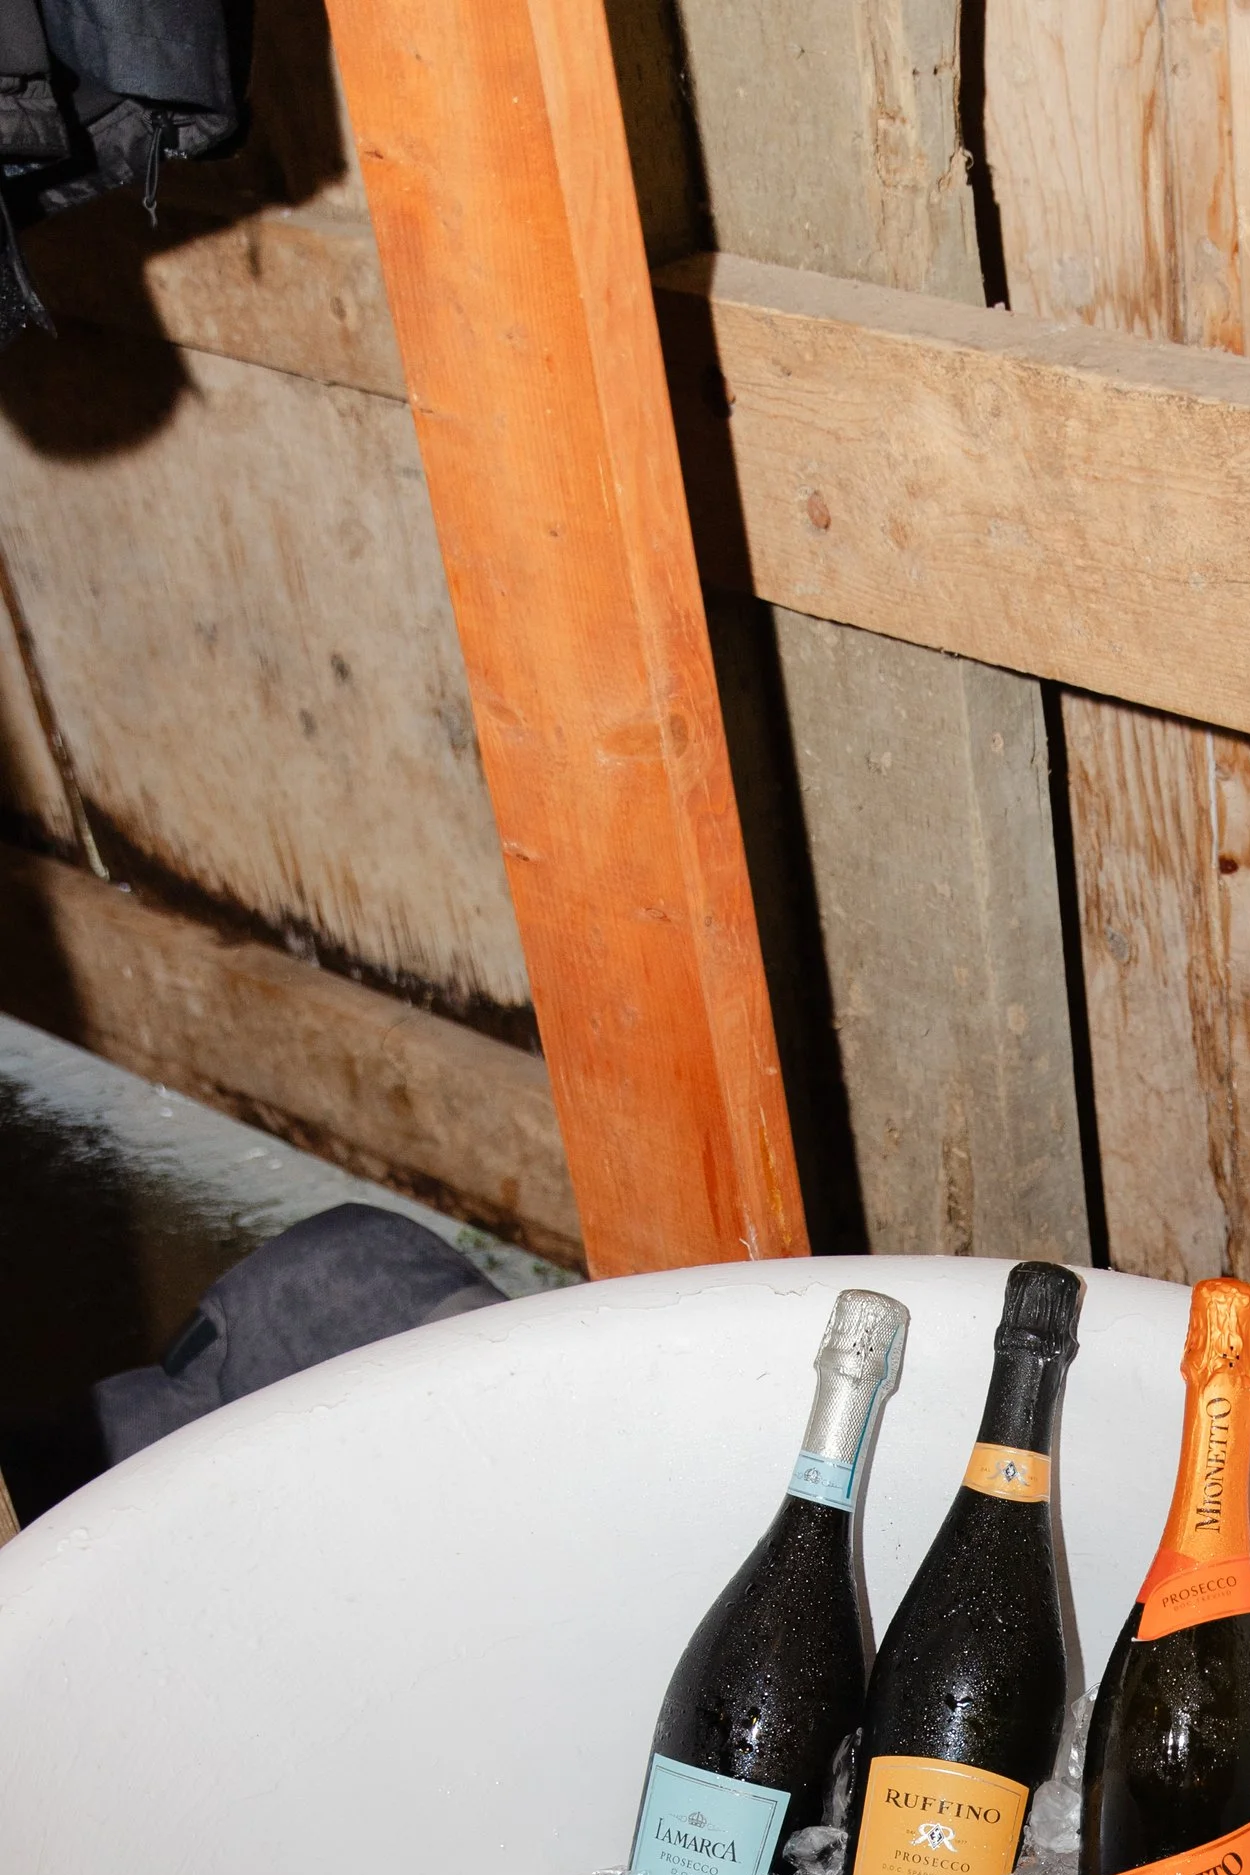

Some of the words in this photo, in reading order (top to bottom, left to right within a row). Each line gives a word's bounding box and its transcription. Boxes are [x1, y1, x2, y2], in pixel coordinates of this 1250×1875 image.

[1194, 1397, 1232, 1533] MIONETTO
[1162, 1575, 1237, 1608] PROSECCO
[885, 1788, 1001, 1824] RUFFINO
[660, 1851, 719, 1875] PROSECCO
[894, 1850, 971, 1873] PROSECCO
